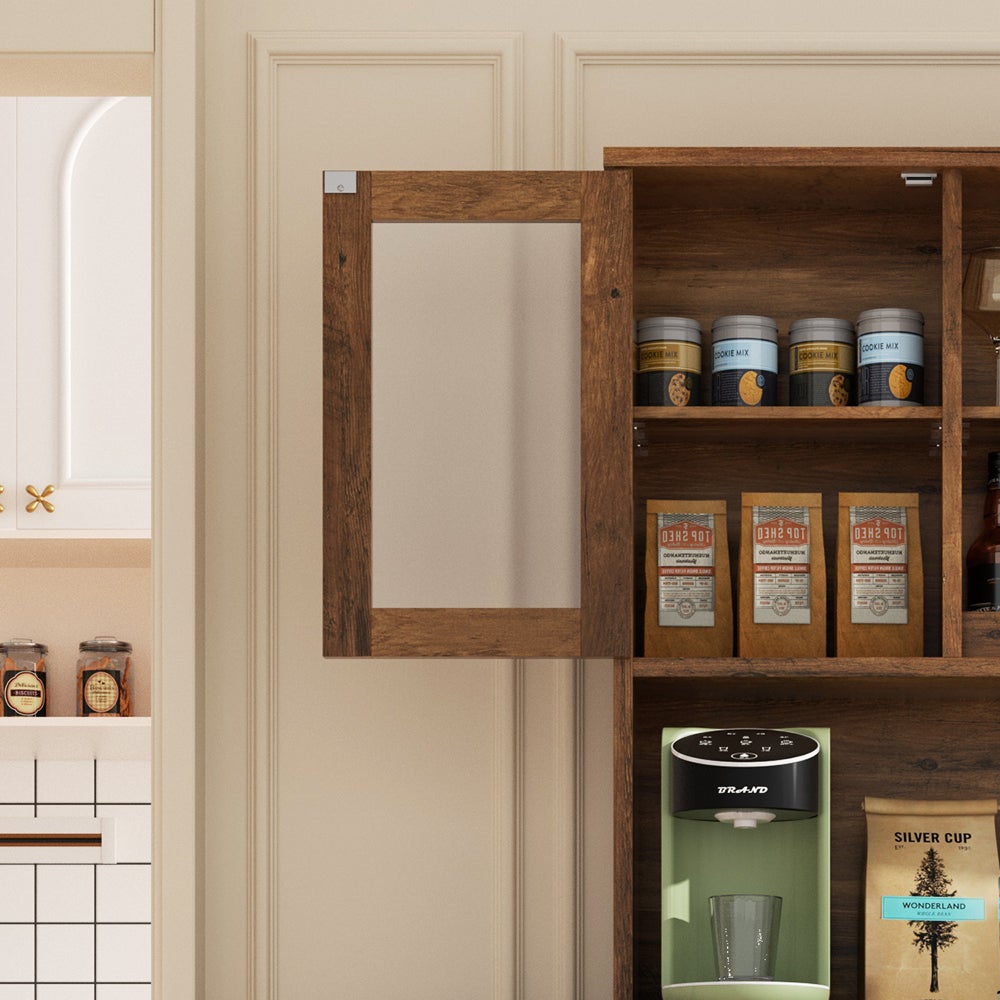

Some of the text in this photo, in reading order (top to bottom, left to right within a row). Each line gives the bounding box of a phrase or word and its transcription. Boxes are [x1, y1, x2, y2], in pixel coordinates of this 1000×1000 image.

[862, 342, 899, 352] COOKIE MIX
[714, 349, 749, 360] COOKIE MIX
[799, 351, 838, 360] COOKIE MIX
[717, 786, 769, 794] BRAND
[894, 831, 972, 844] SILVER CUP
[902, 902, 966, 910] WONDERLAND
